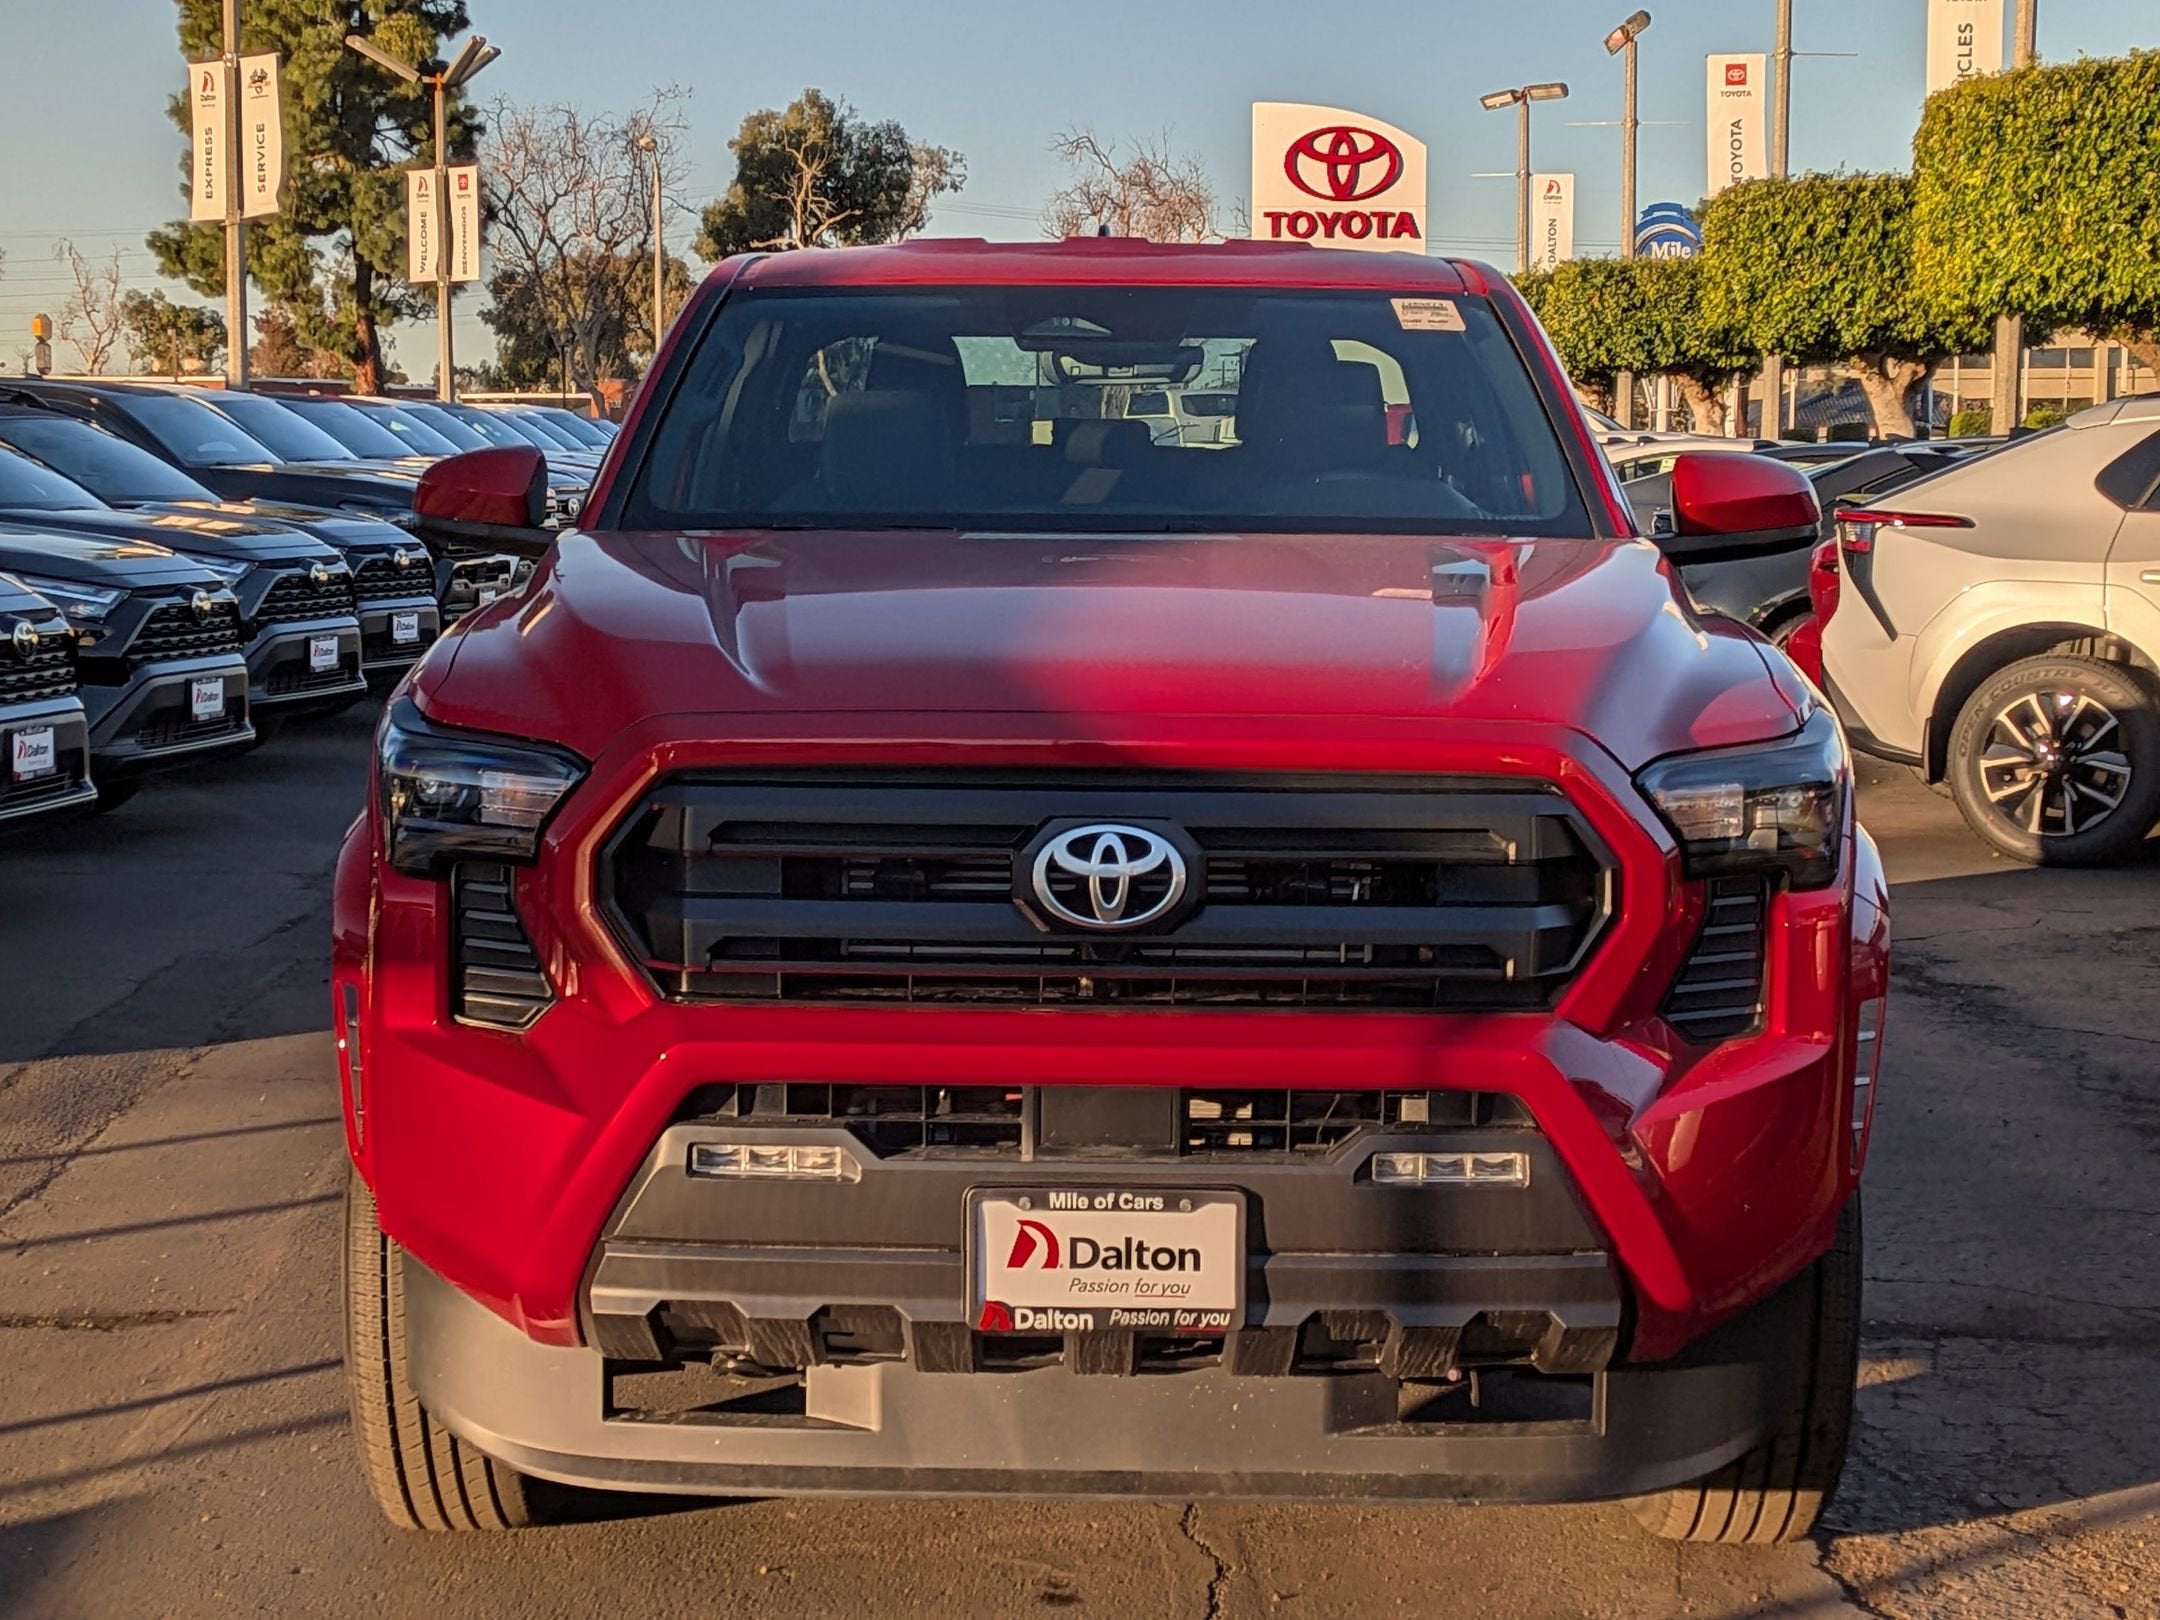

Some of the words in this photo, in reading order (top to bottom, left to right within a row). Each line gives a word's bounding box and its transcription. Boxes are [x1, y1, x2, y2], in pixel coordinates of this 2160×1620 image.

[1720, 90, 1752, 98] TOYOTA
[204, 126, 214, 200] EXPRESS
[256, 122, 266, 194] SERVICE
[1730, 118, 1743, 184] TOYOTA
[419, 211, 428, 273] WELCOME
[1263, 211, 1422, 239] TOYOTA
[1547, 218, 1558, 264] DALTON
[1651, 240, 1691, 260] Mile
[1959, 706, 1985, 757] OPEN
[1991, 670, 2083, 702] COUNTRY
[1049, 1192, 1089, 1209] Mile
[1094, 1193, 1115, 1209] of
[1119, 1193, 1164, 1210] Cars
[1069, 1236, 1201, 1271] Dalton
[1068, 1278, 1129, 1293] Passion
[1135, 1278, 1158, 1294] for
[1161, 1284, 1191, 1296] you
[1015, 1309, 1094, 1331] Dalton
[1109, 1310, 1169, 1326] Passion
[1174, 1309, 1198, 1327] for
[1199, 1313, 1231, 1329] you
